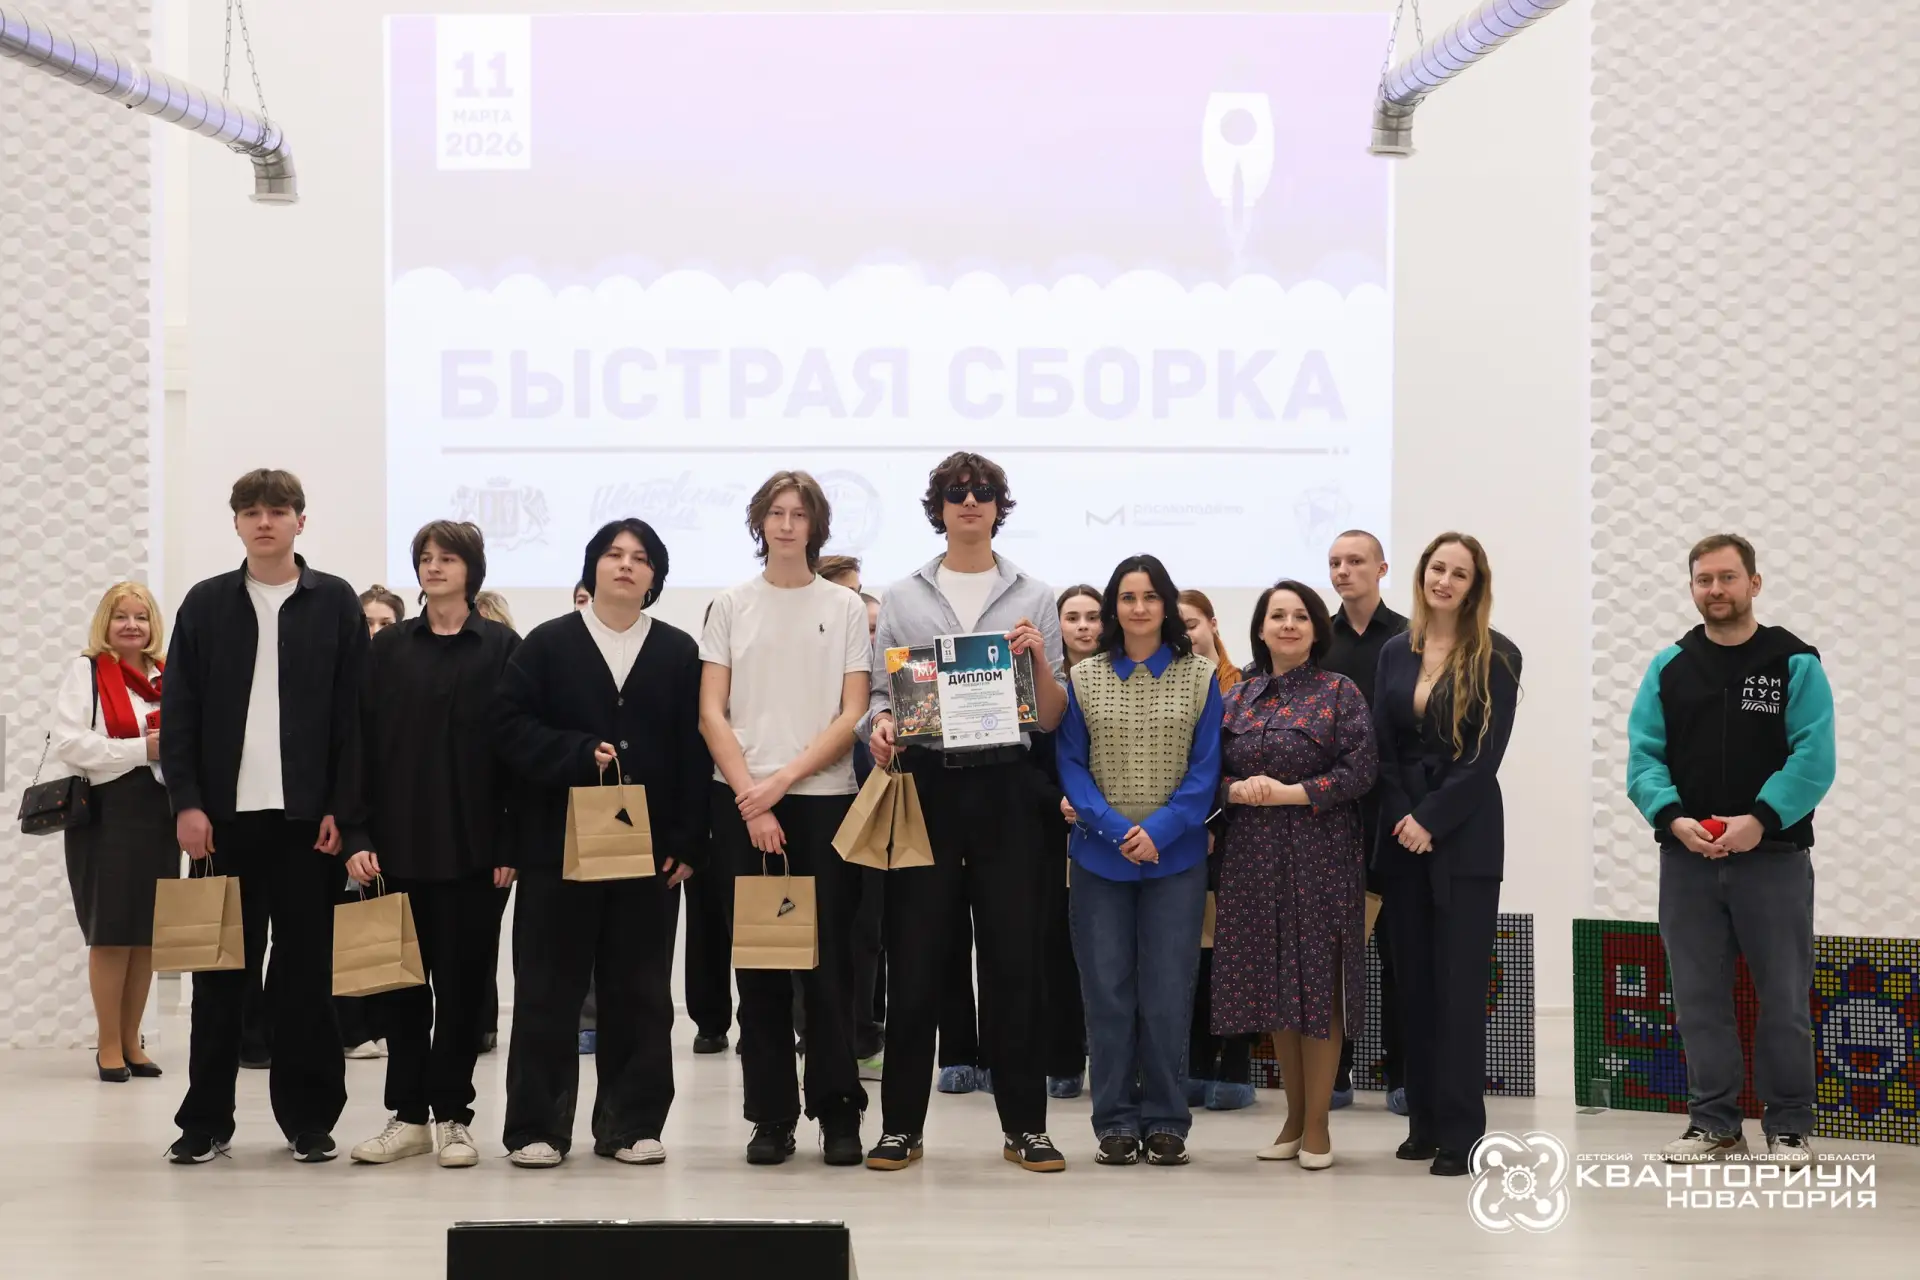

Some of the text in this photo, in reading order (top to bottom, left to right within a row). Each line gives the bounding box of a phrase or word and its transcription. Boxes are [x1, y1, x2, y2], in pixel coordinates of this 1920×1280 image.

[453, 51, 514, 98] 11
[452, 108, 513, 124] МАРТА
[445, 130, 524, 158] 2026
[440, 346, 1349, 422] БЫСТРАЯ СБОРКА
[948, 671, 1003, 686] ДИПЛОМ
